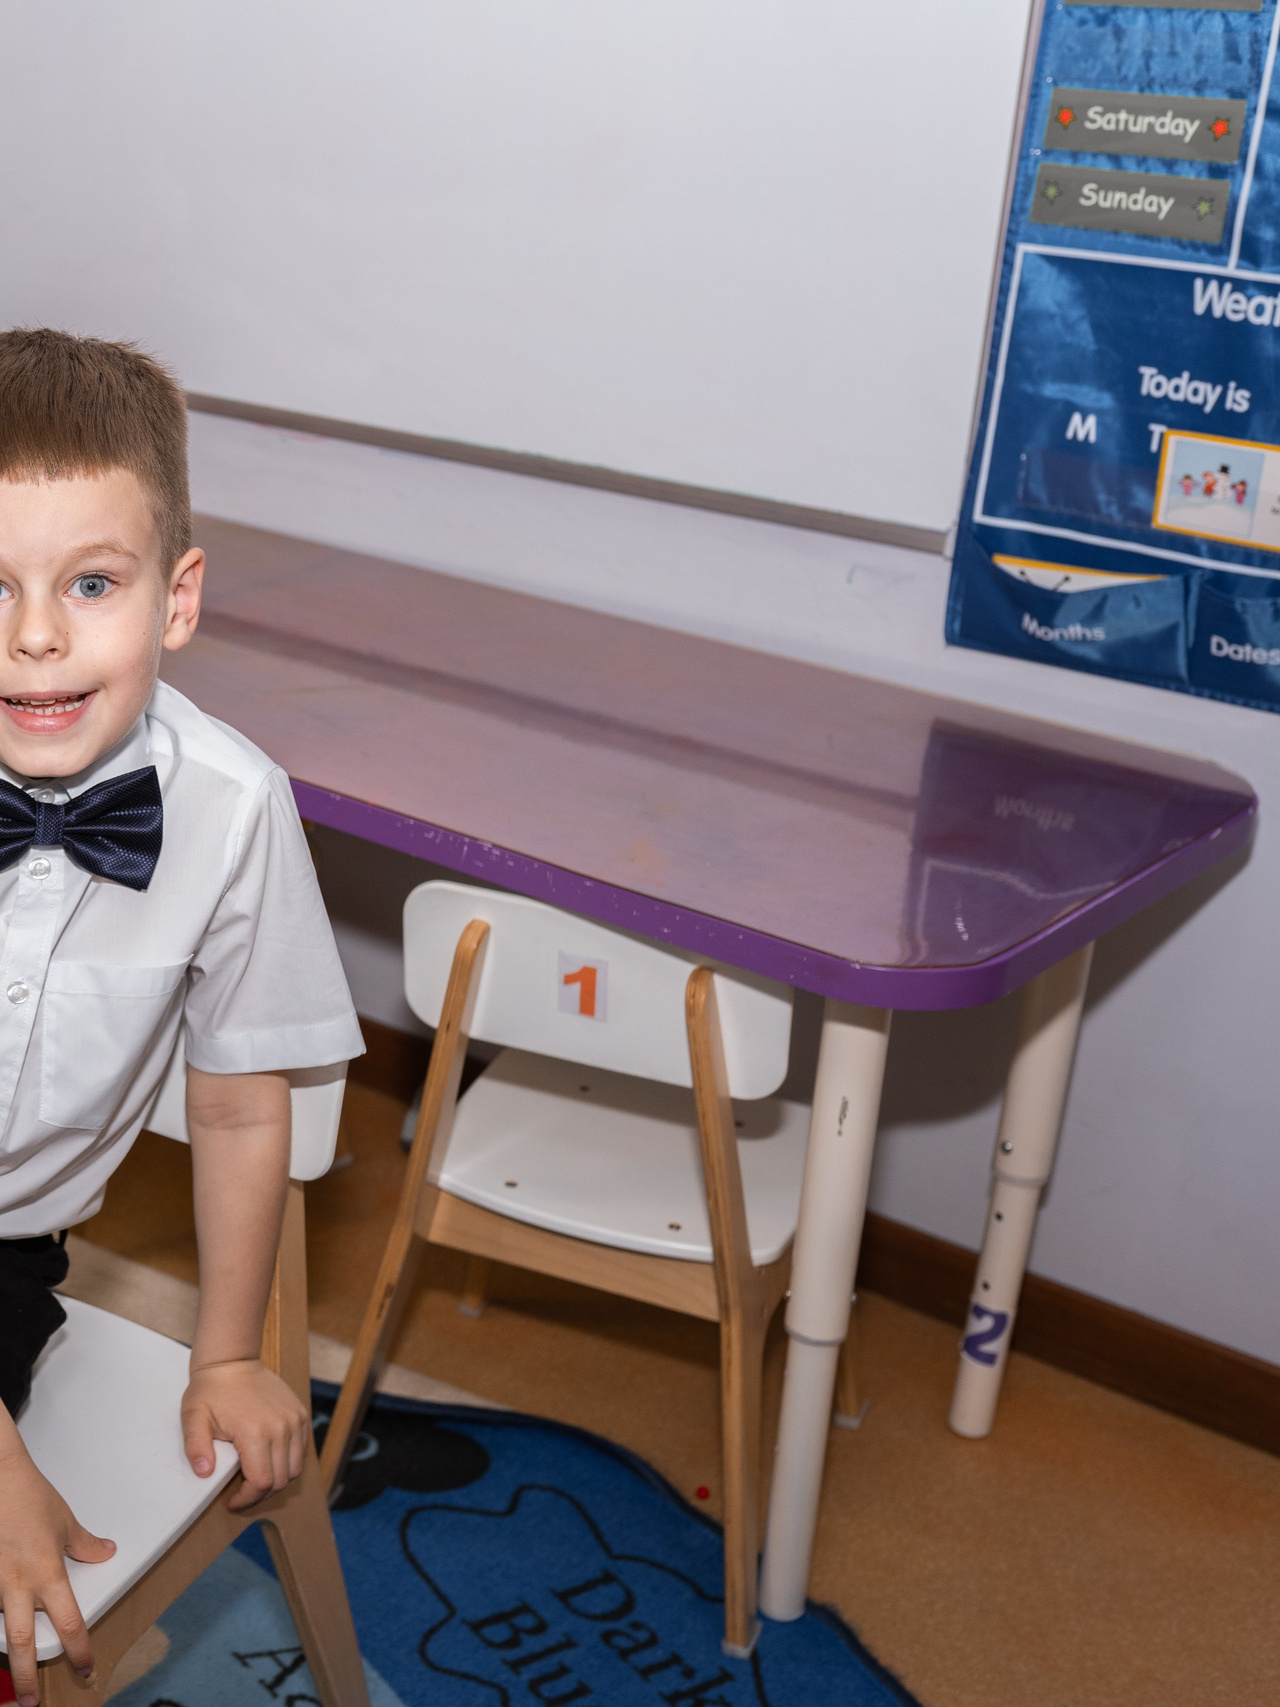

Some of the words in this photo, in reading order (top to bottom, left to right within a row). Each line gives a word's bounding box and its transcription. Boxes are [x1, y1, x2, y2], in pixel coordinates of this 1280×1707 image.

[1084, 105, 1200, 143] Saturday
[1078, 182, 1175, 220] Sunday
[1138, 365, 1223, 414] Today
[1224, 380, 1252, 413] is
[1065, 411, 1098, 443] M
[1148, 423, 1167, 453] T
[1021, 611, 1107, 643] Months
[1210, 634, 1280, 666] Dates
[562, 964, 597, 1017] 1
[962, 1303, 1009, 1366] 2
